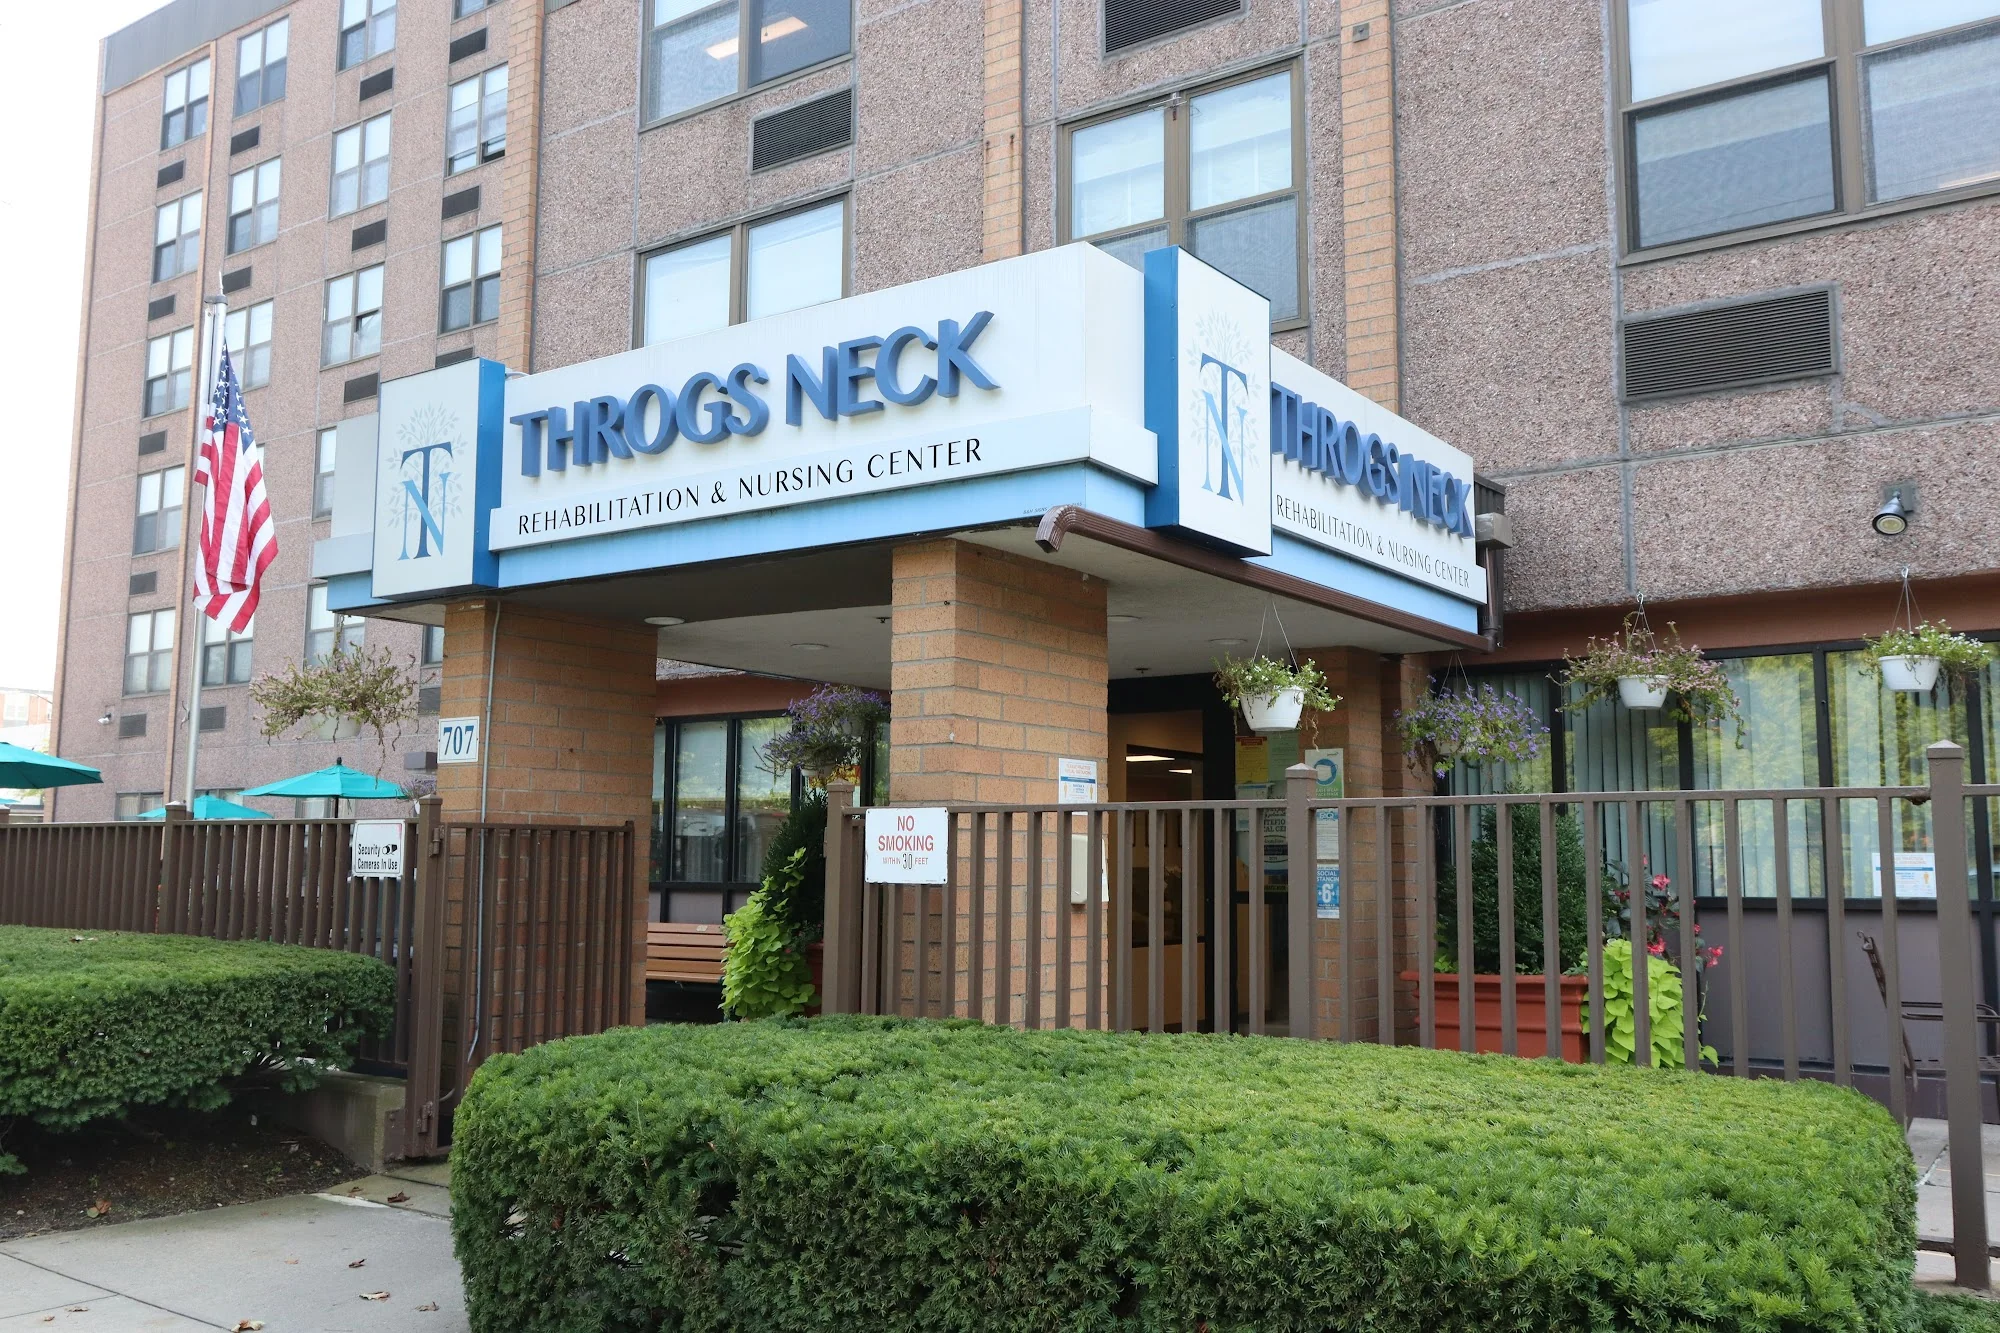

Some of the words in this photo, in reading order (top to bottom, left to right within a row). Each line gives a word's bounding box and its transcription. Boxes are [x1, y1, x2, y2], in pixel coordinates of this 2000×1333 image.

[510, 362, 769, 478] THROGS
[786, 310, 1001, 427] NECK
[1271, 381, 1400, 504] THROGS
[1400, 453, 1475, 539] NECK
[518, 485, 699, 535] REHABILITATION
[710, 480, 727, 504] &
[739, 459, 853, 499] NURSING
[867, 438, 982, 478] CENTER
[1276, 494, 1373, 549] REHABILITATION
[1376, 535, 1384, 556] &
[1388, 540, 1431, 574] NURSING
[1434, 559, 1470, 588] CENTER
[443, 725, 475, 755] 707
[897, 815, 915, 831] NO
[358, 843, 382, 858] Security
[878, 835, 934, 851] SMOKING
[358, 858, 380, 870] Cameras
[381, 859, 387, 870] In
[388, 859, 398, 870] Use
[882, 857, 901, 865] WITHIN
[903, 853, 913, 870] 30
[914, 857, 929, 865] FEET
